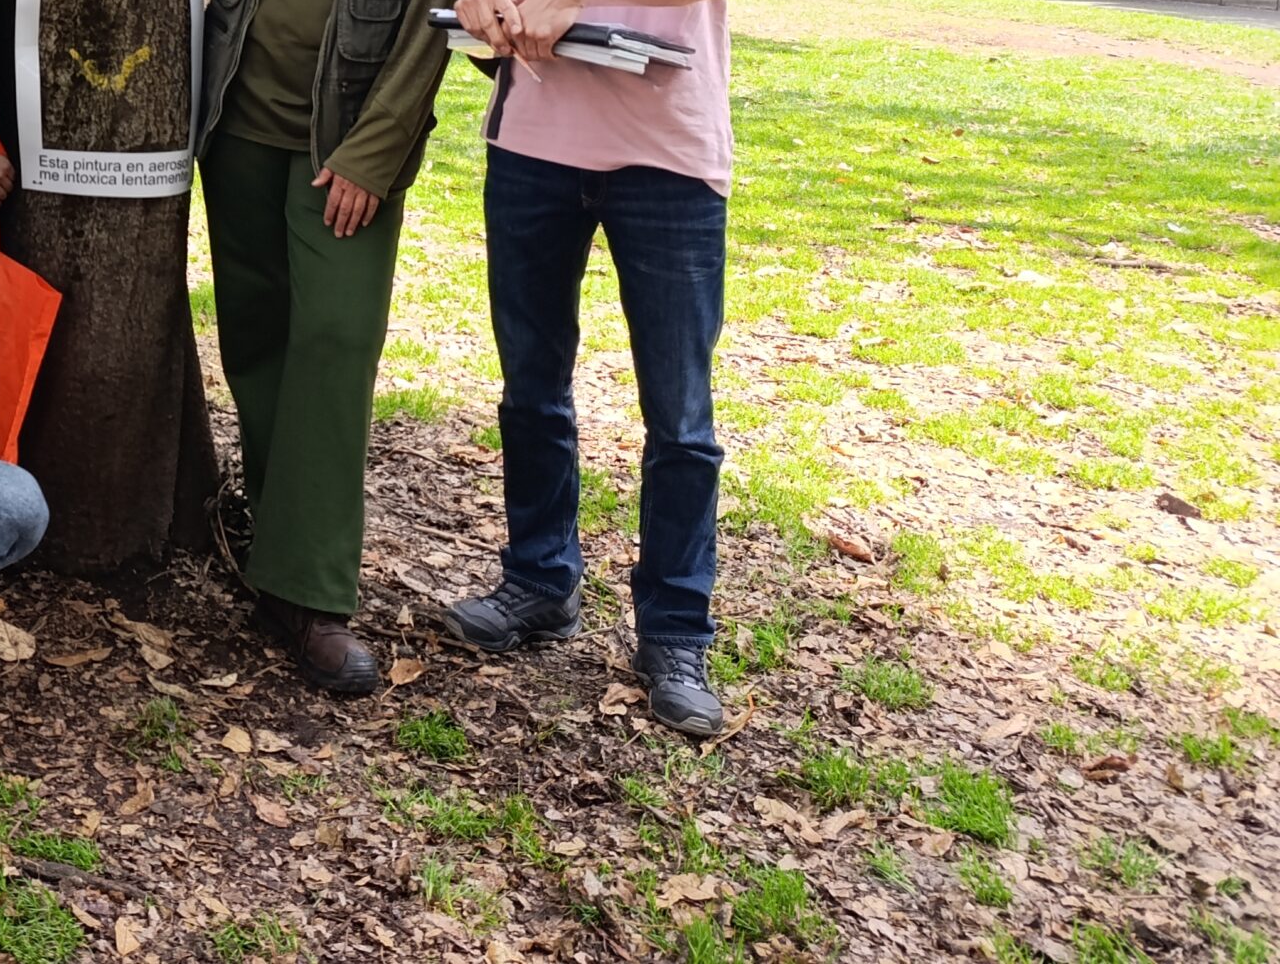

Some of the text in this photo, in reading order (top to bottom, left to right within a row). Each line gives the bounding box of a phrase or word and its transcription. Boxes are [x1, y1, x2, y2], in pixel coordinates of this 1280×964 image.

[39, 155, 190, 172] Esta pintura en aerosol
[39, 170, 189, 186] me intoxica lentamente
